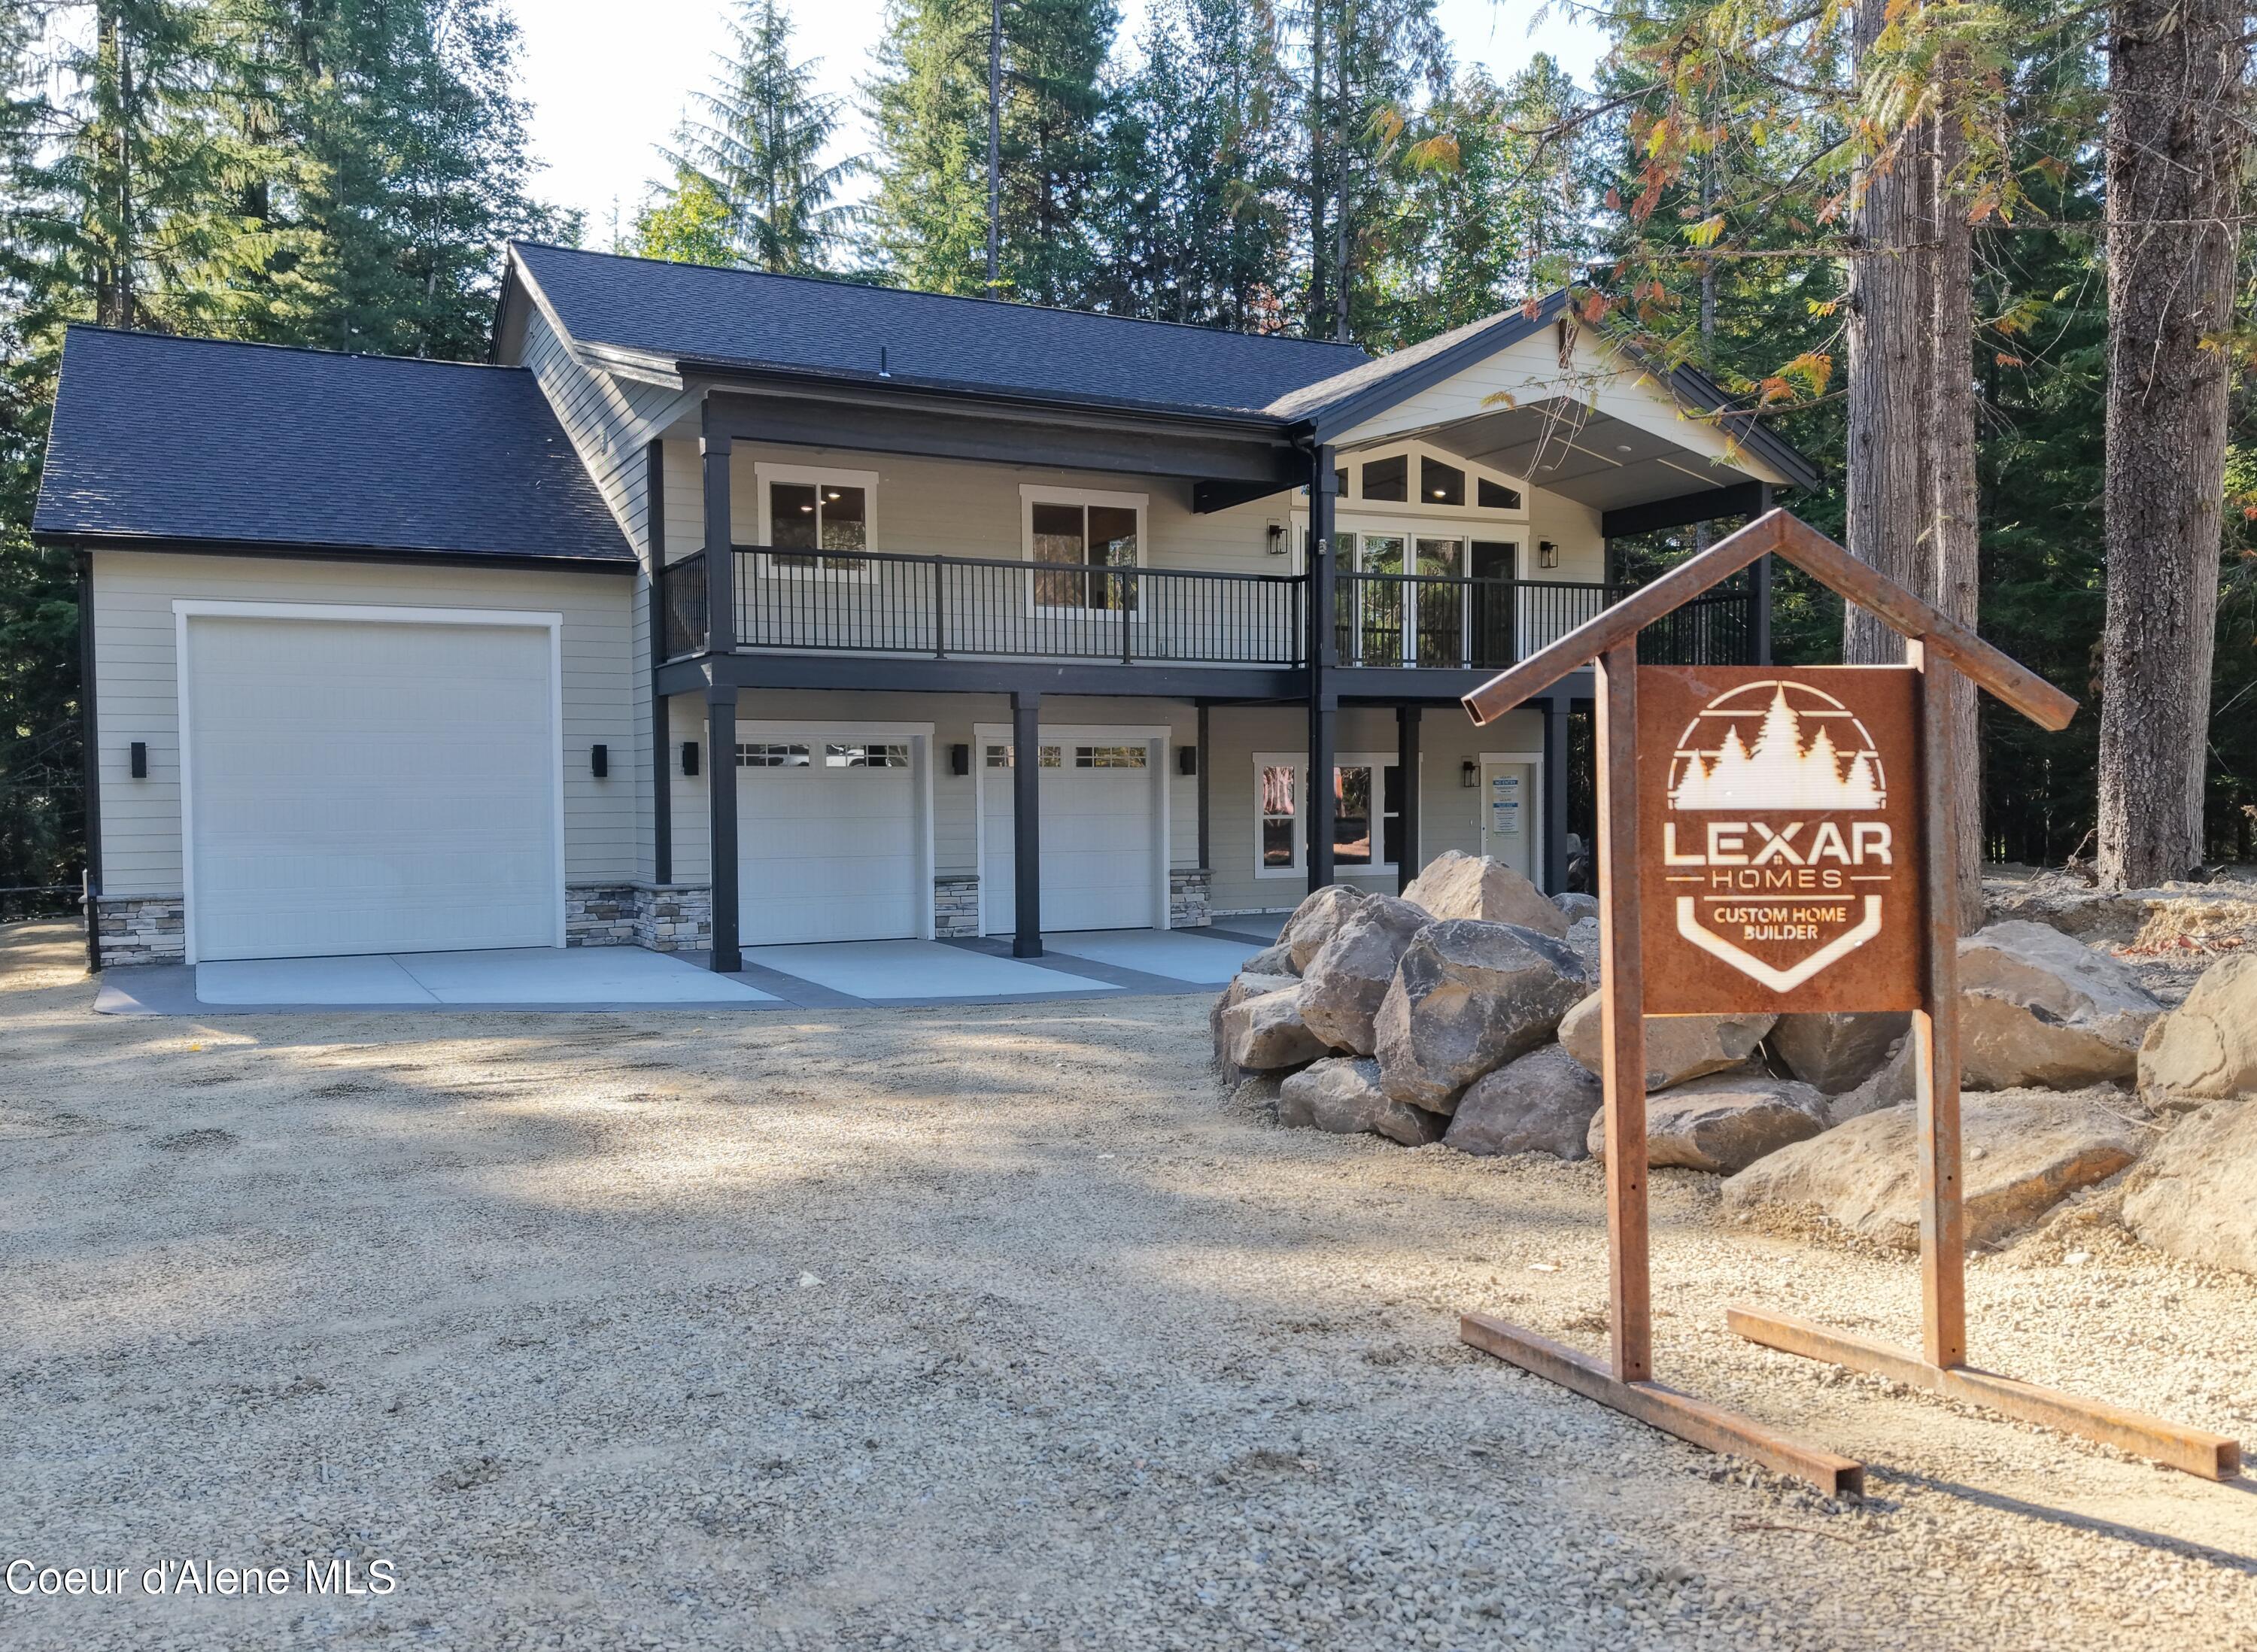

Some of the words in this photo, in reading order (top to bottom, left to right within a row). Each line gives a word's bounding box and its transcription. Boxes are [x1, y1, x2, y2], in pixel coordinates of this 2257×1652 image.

[1664, 822, 1892, 866] LEXAR
[1712, 870, 1842, 888] HOMES
[1713, 907, 1788, 923] CUSTOM
[1792, 907, 1846, 922] HOME
[1743, 925, 1818, 940] BUILDER
